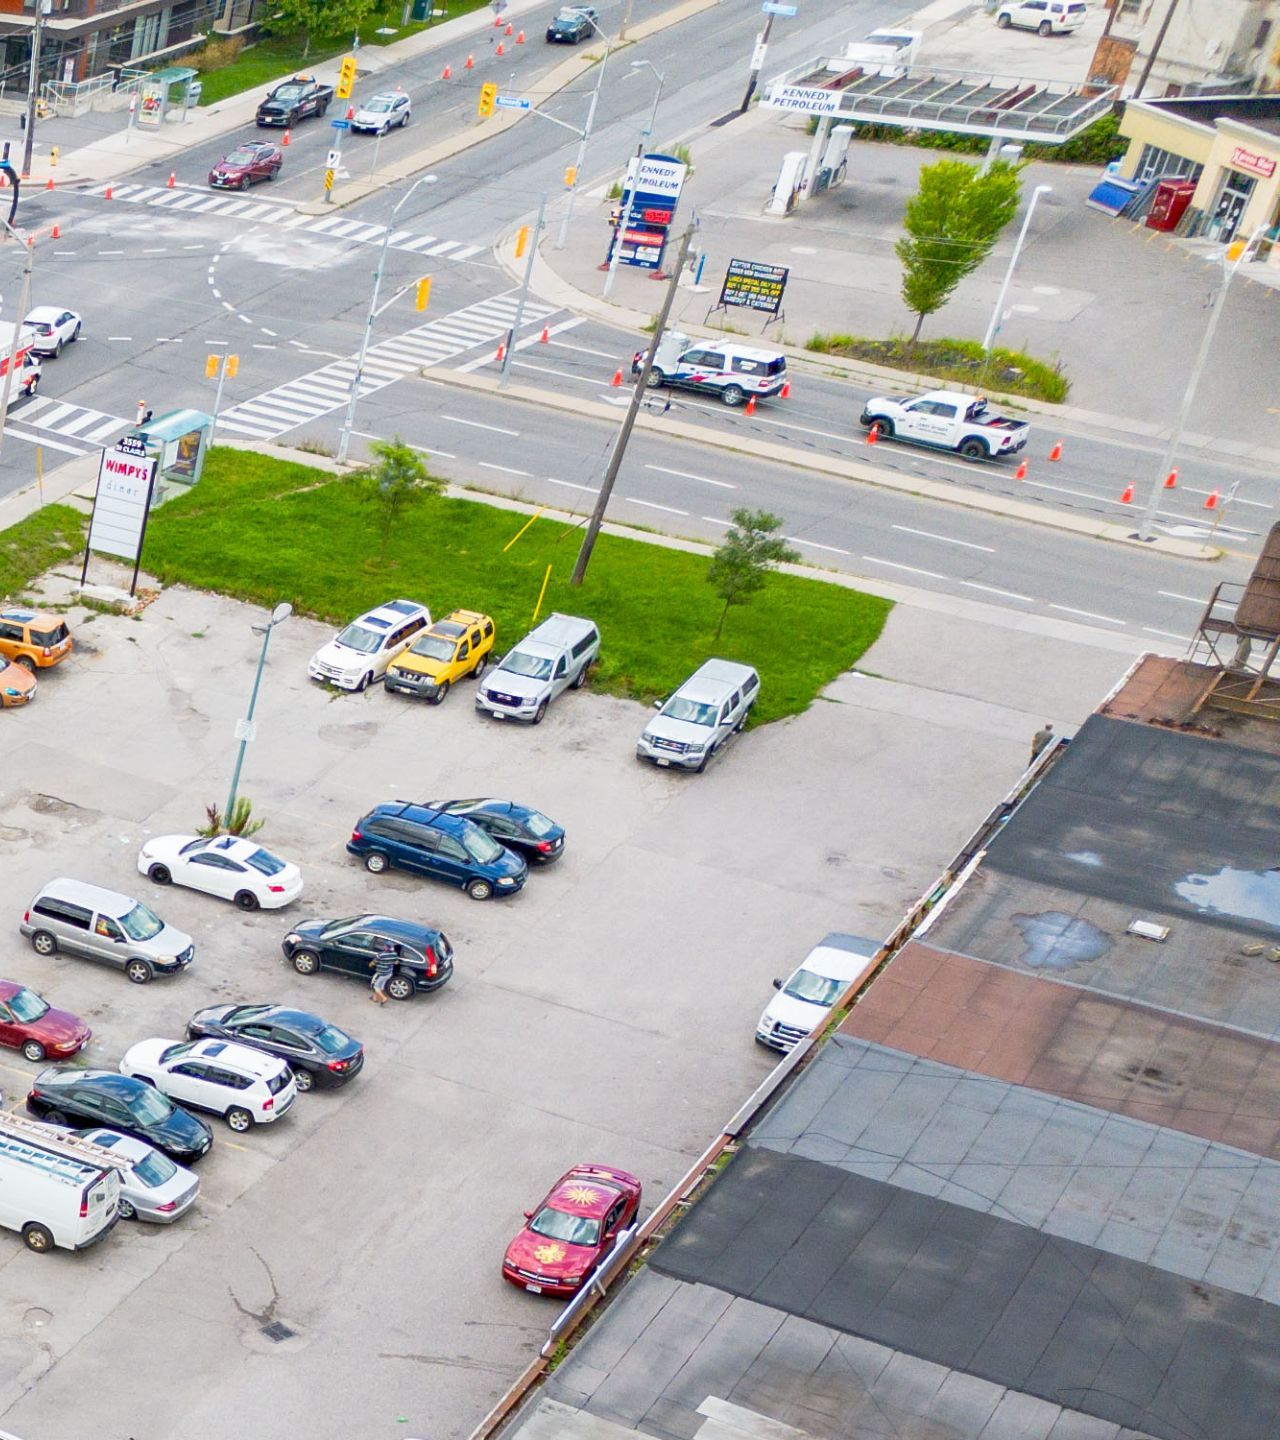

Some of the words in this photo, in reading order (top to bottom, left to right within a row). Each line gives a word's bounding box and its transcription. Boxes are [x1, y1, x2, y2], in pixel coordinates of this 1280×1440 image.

[783, 88, 832, 101] KENNEDY
[773, 98, 836, 112] PETROLEUM
[640, 165, 677, 177] ENNEDY
[627, 175, 679, 190] PTROLEUM
